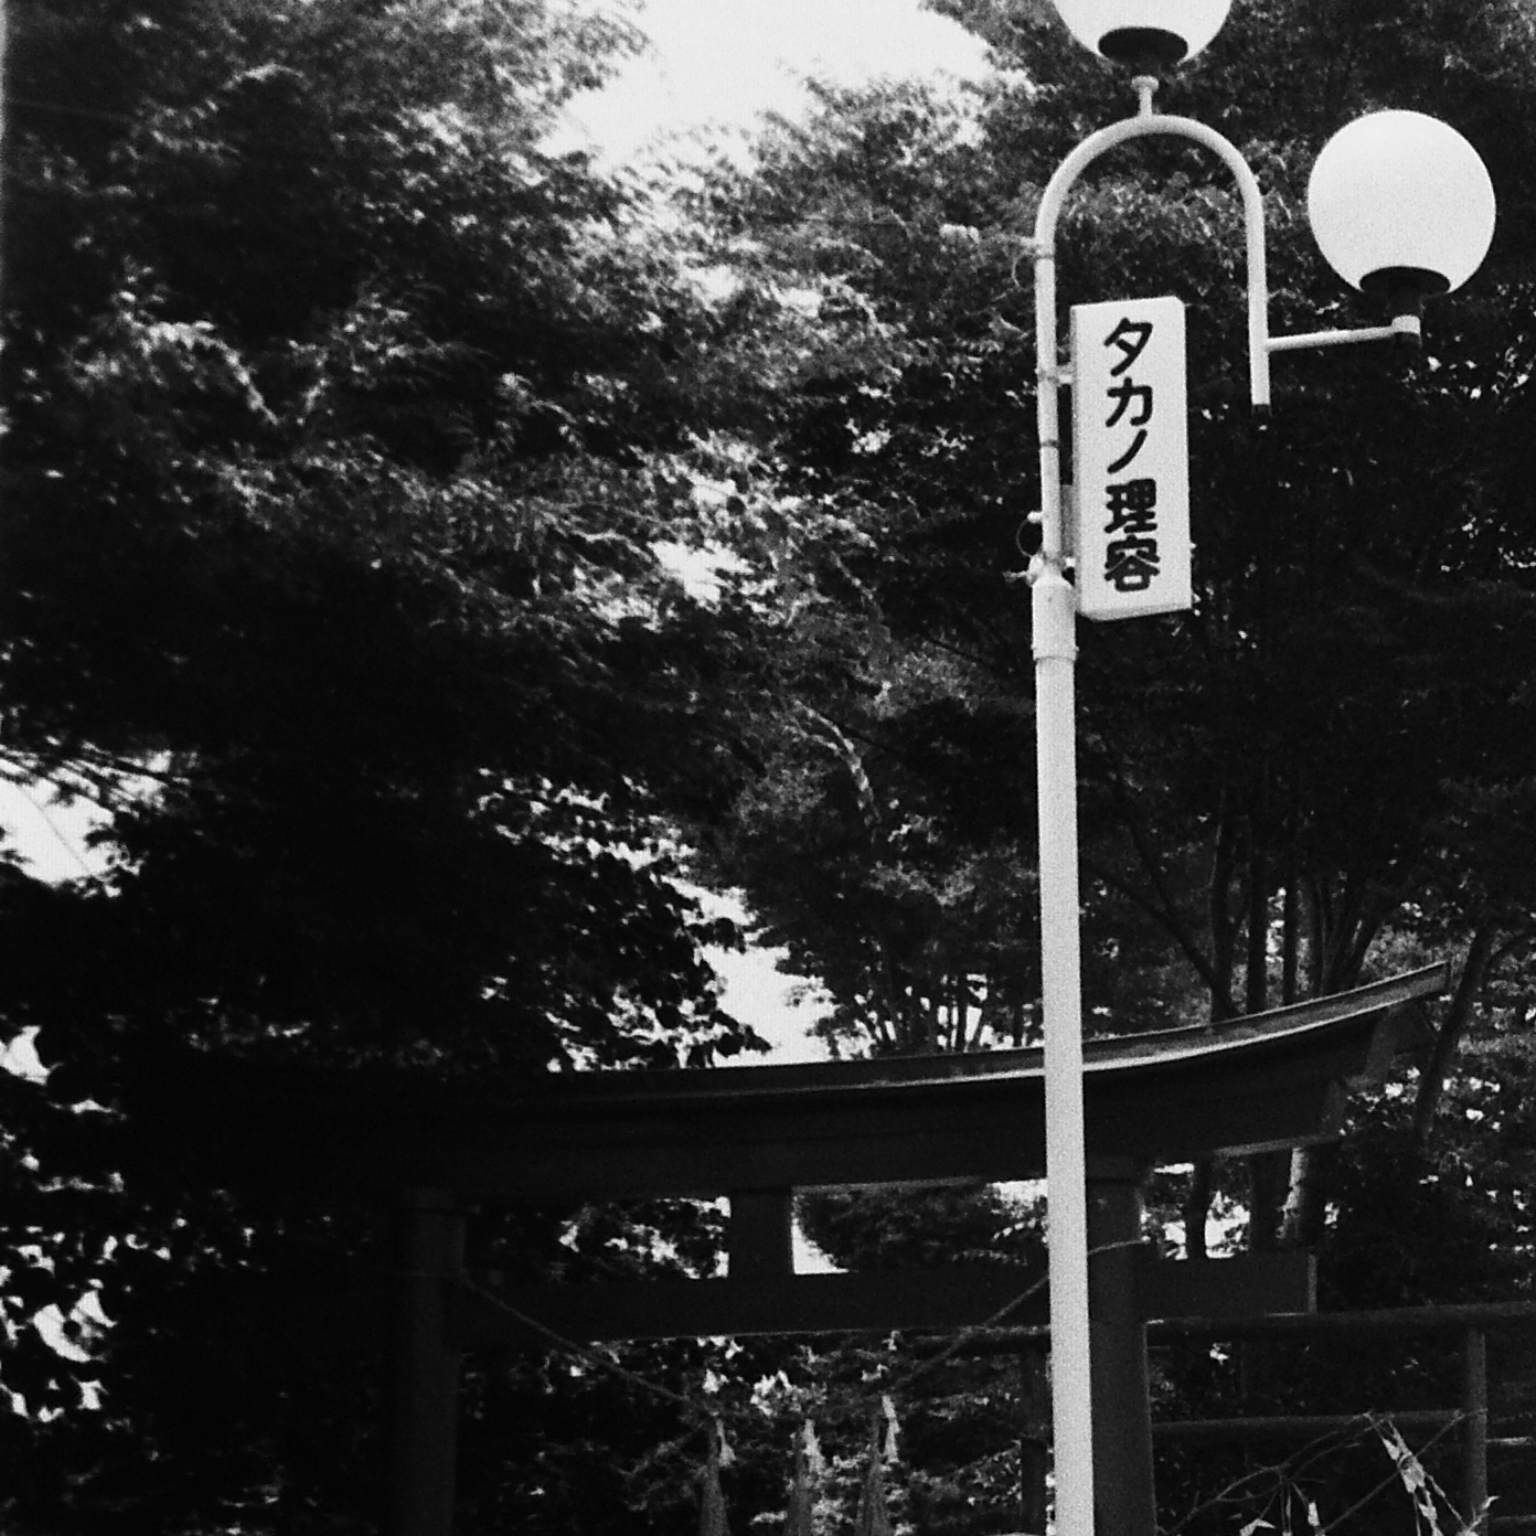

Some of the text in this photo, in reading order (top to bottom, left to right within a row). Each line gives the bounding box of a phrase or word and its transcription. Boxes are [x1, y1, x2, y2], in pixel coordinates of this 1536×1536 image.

[1104, 317, 1160, 592] タカノ理容
